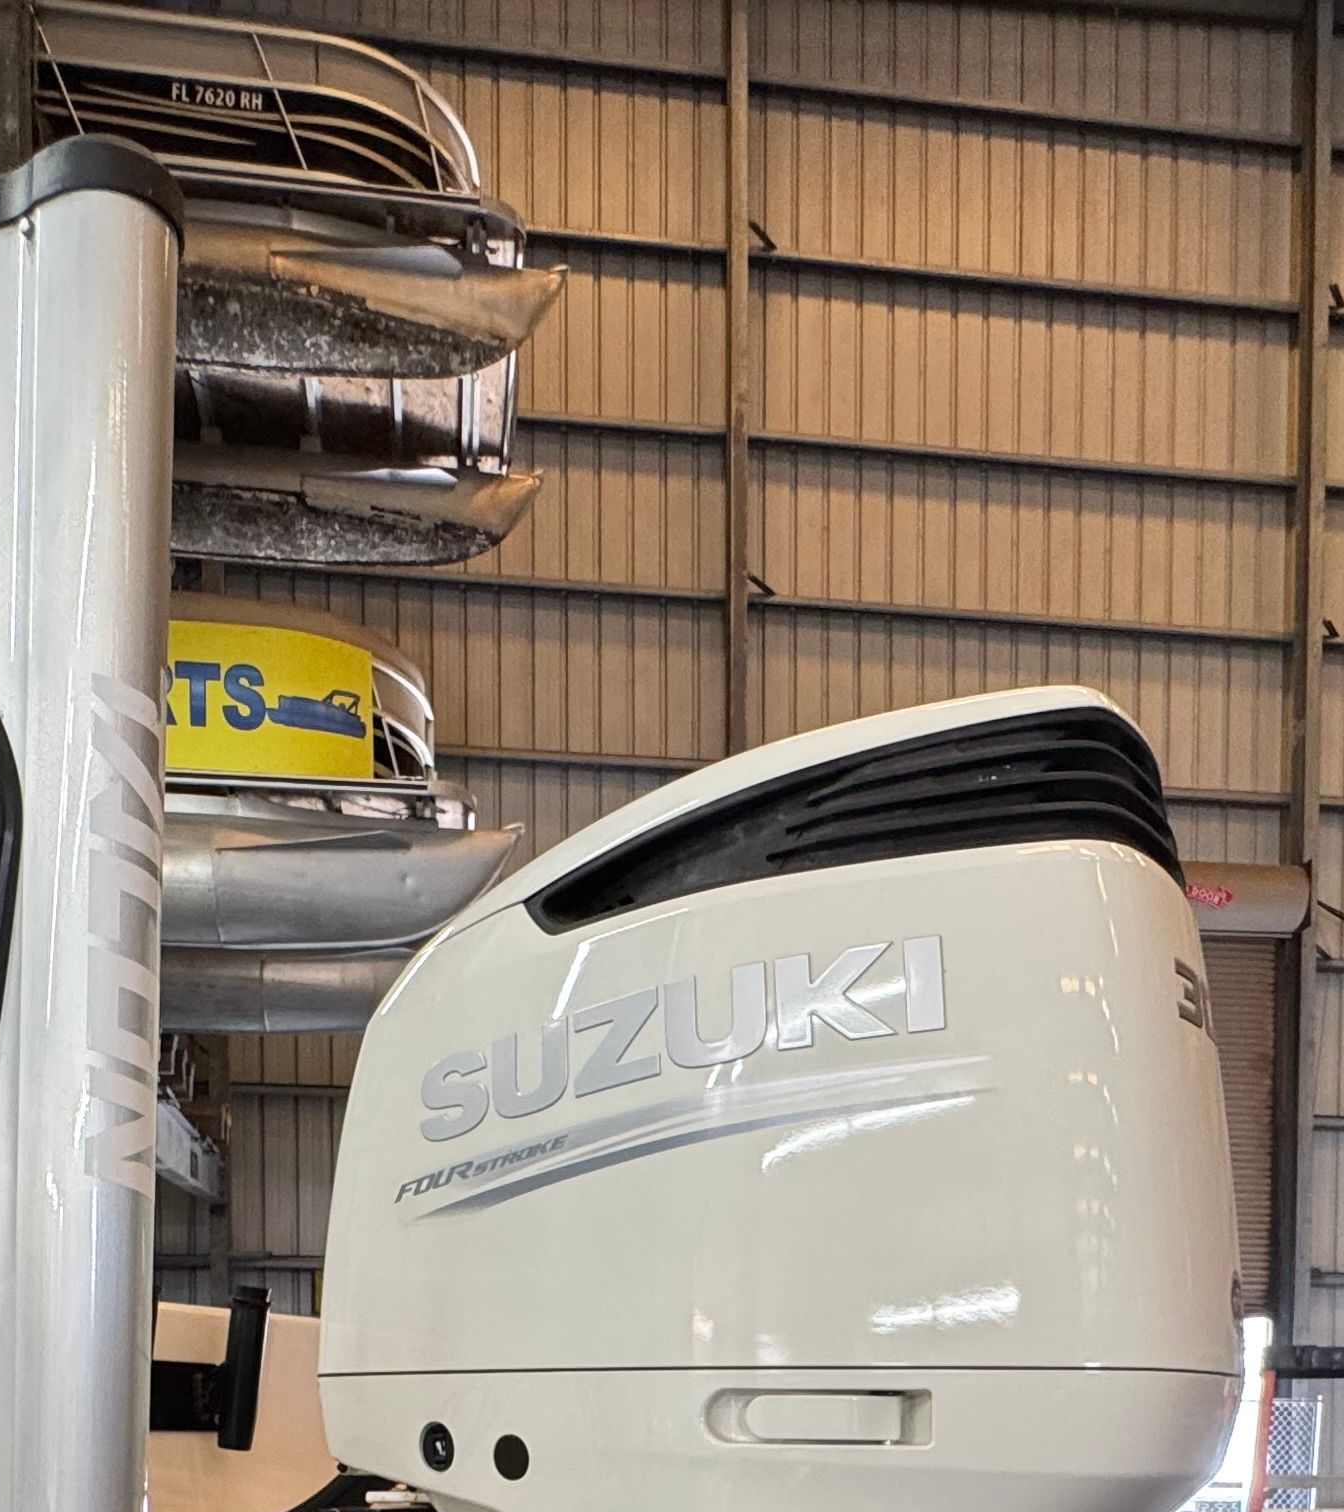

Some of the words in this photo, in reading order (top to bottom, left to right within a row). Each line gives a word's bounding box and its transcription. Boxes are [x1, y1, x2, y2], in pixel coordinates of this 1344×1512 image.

[171, 82, 190, 103] FL
[195, 85, 236, 108] 7620
[240, 91, 263, 111] RH
[420, 935, 947, 1142] SUZUKI
[394, 1161, 474, 1204] FOUR
